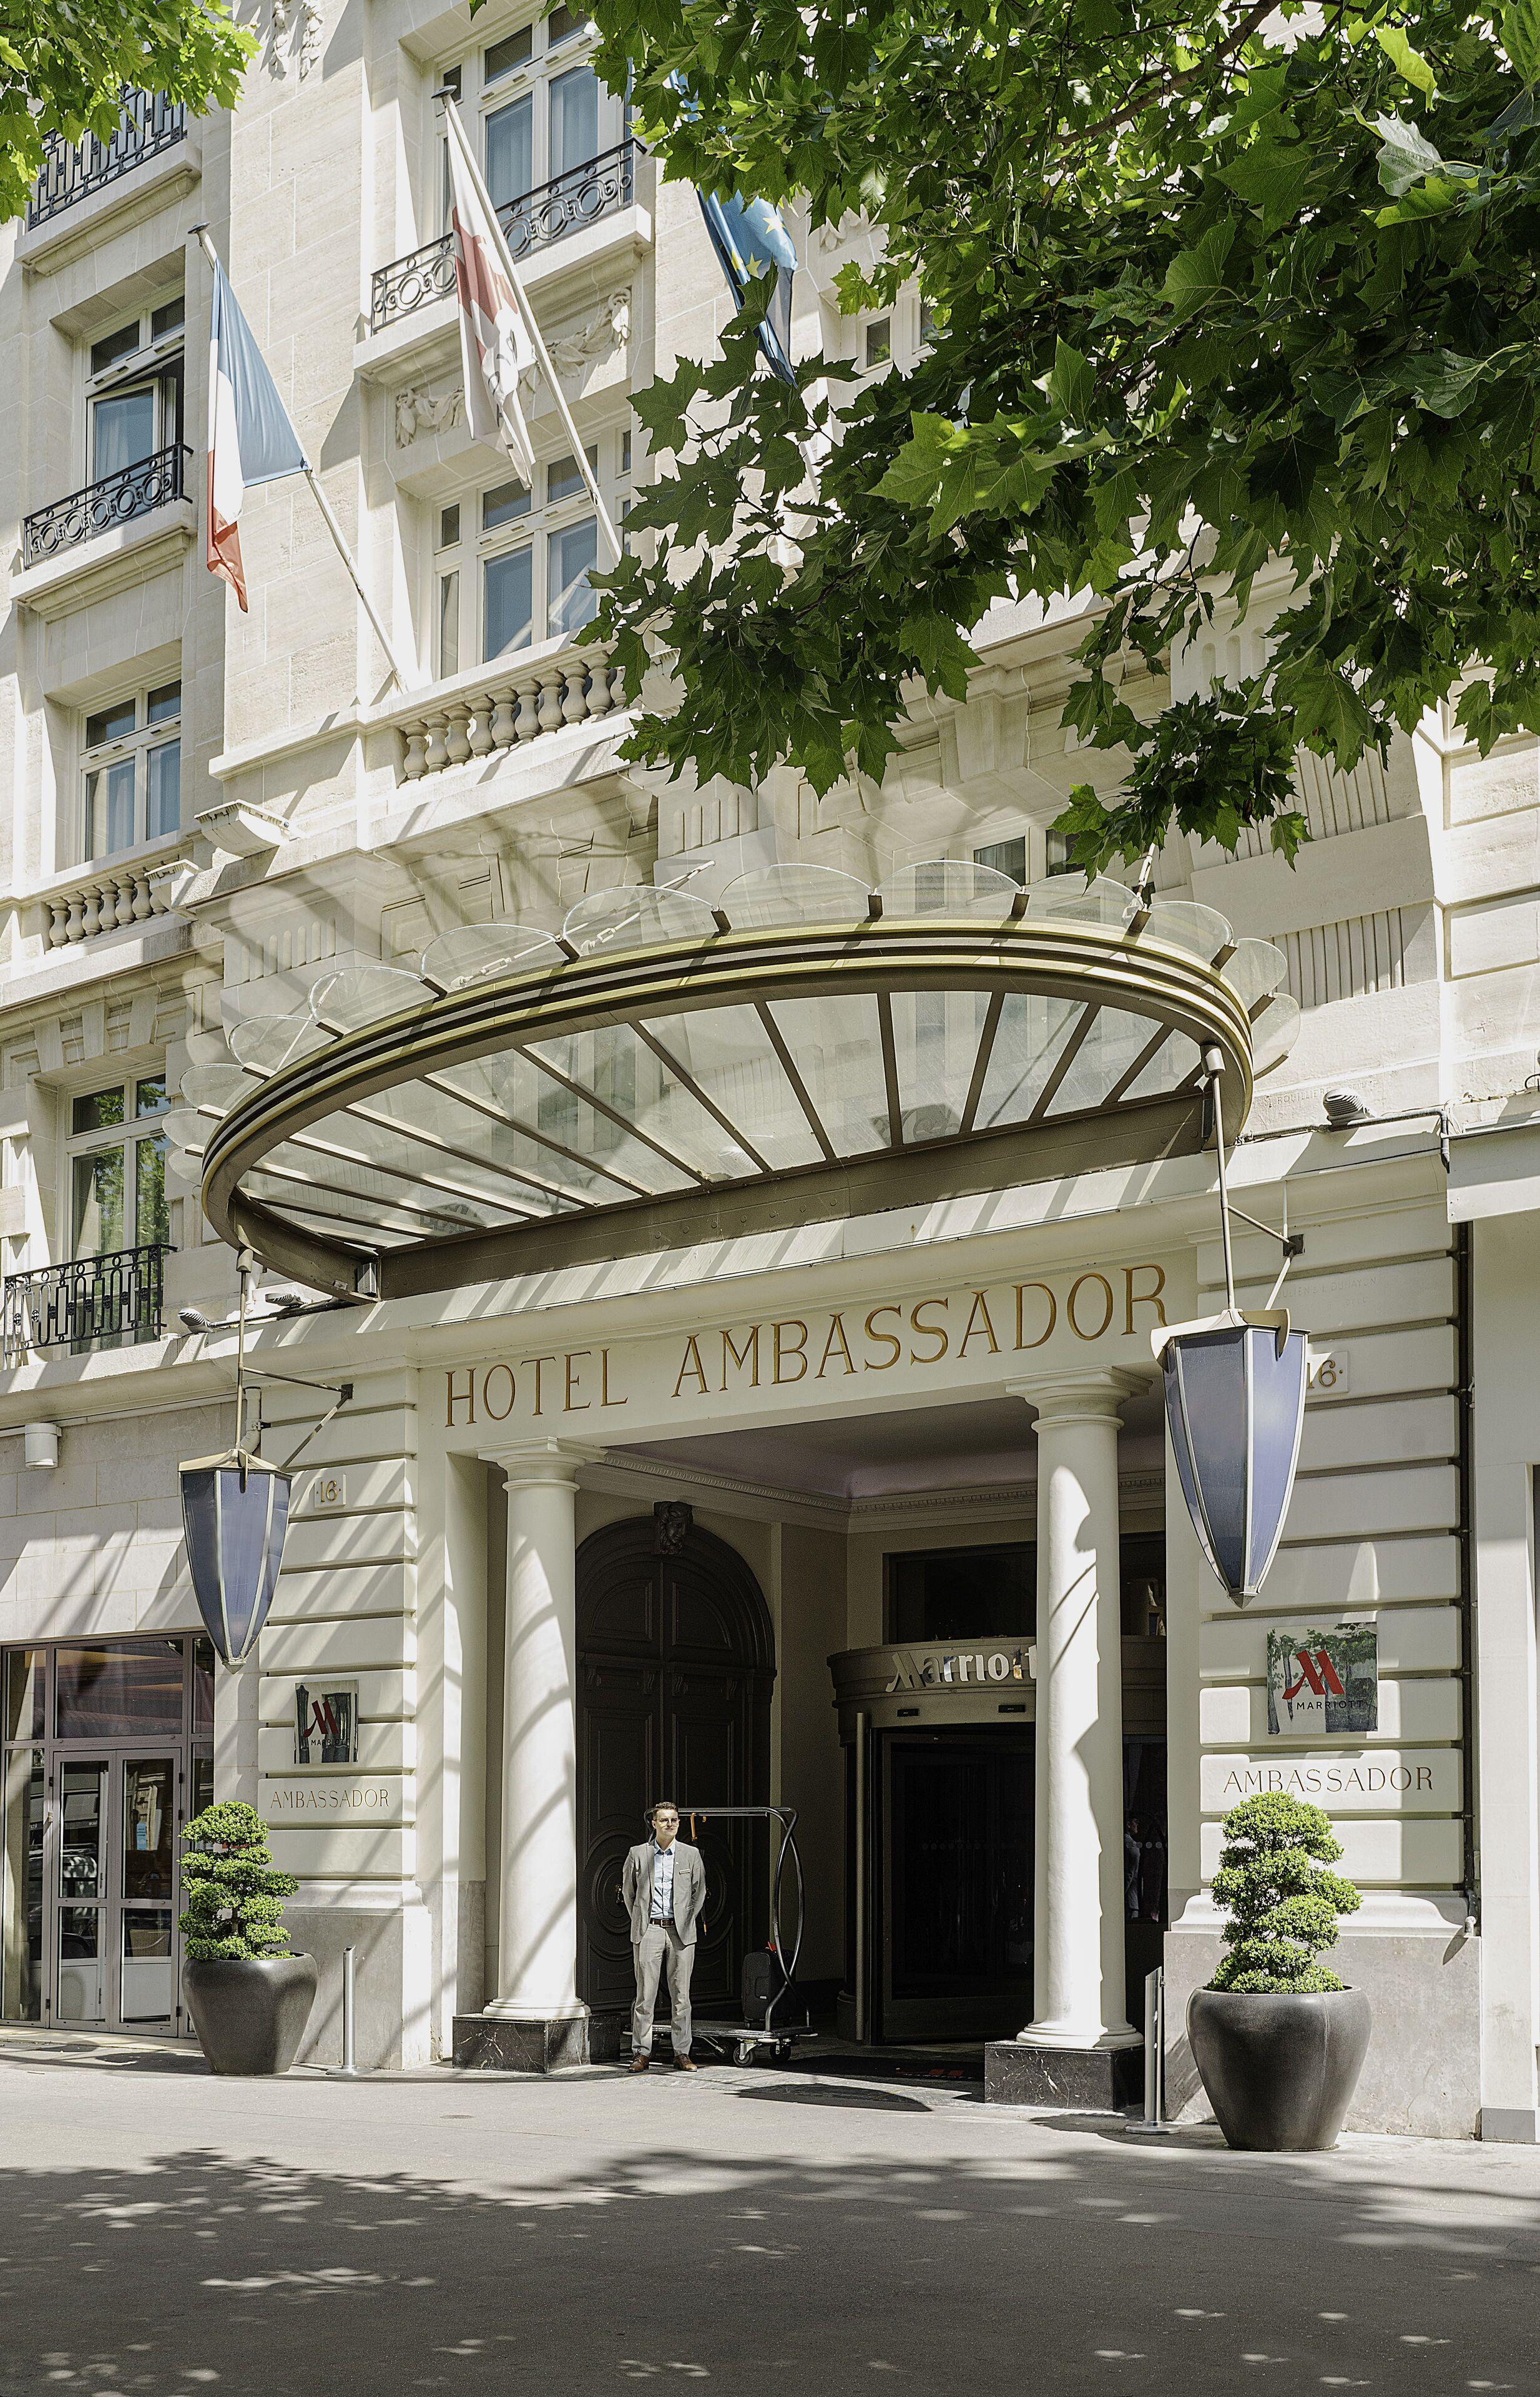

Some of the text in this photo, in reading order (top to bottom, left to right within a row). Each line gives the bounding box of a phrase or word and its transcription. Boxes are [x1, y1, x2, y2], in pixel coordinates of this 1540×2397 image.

[444, 1263, 1169, 1428] HOTEL AMBASSADOR
[1297, 1700, 1364, 1710] MARRIOTT
[1223, 1767, 1433, 1793] AMBASSADOR
[270, 1789, 389, 1808] AMBASSADOR
